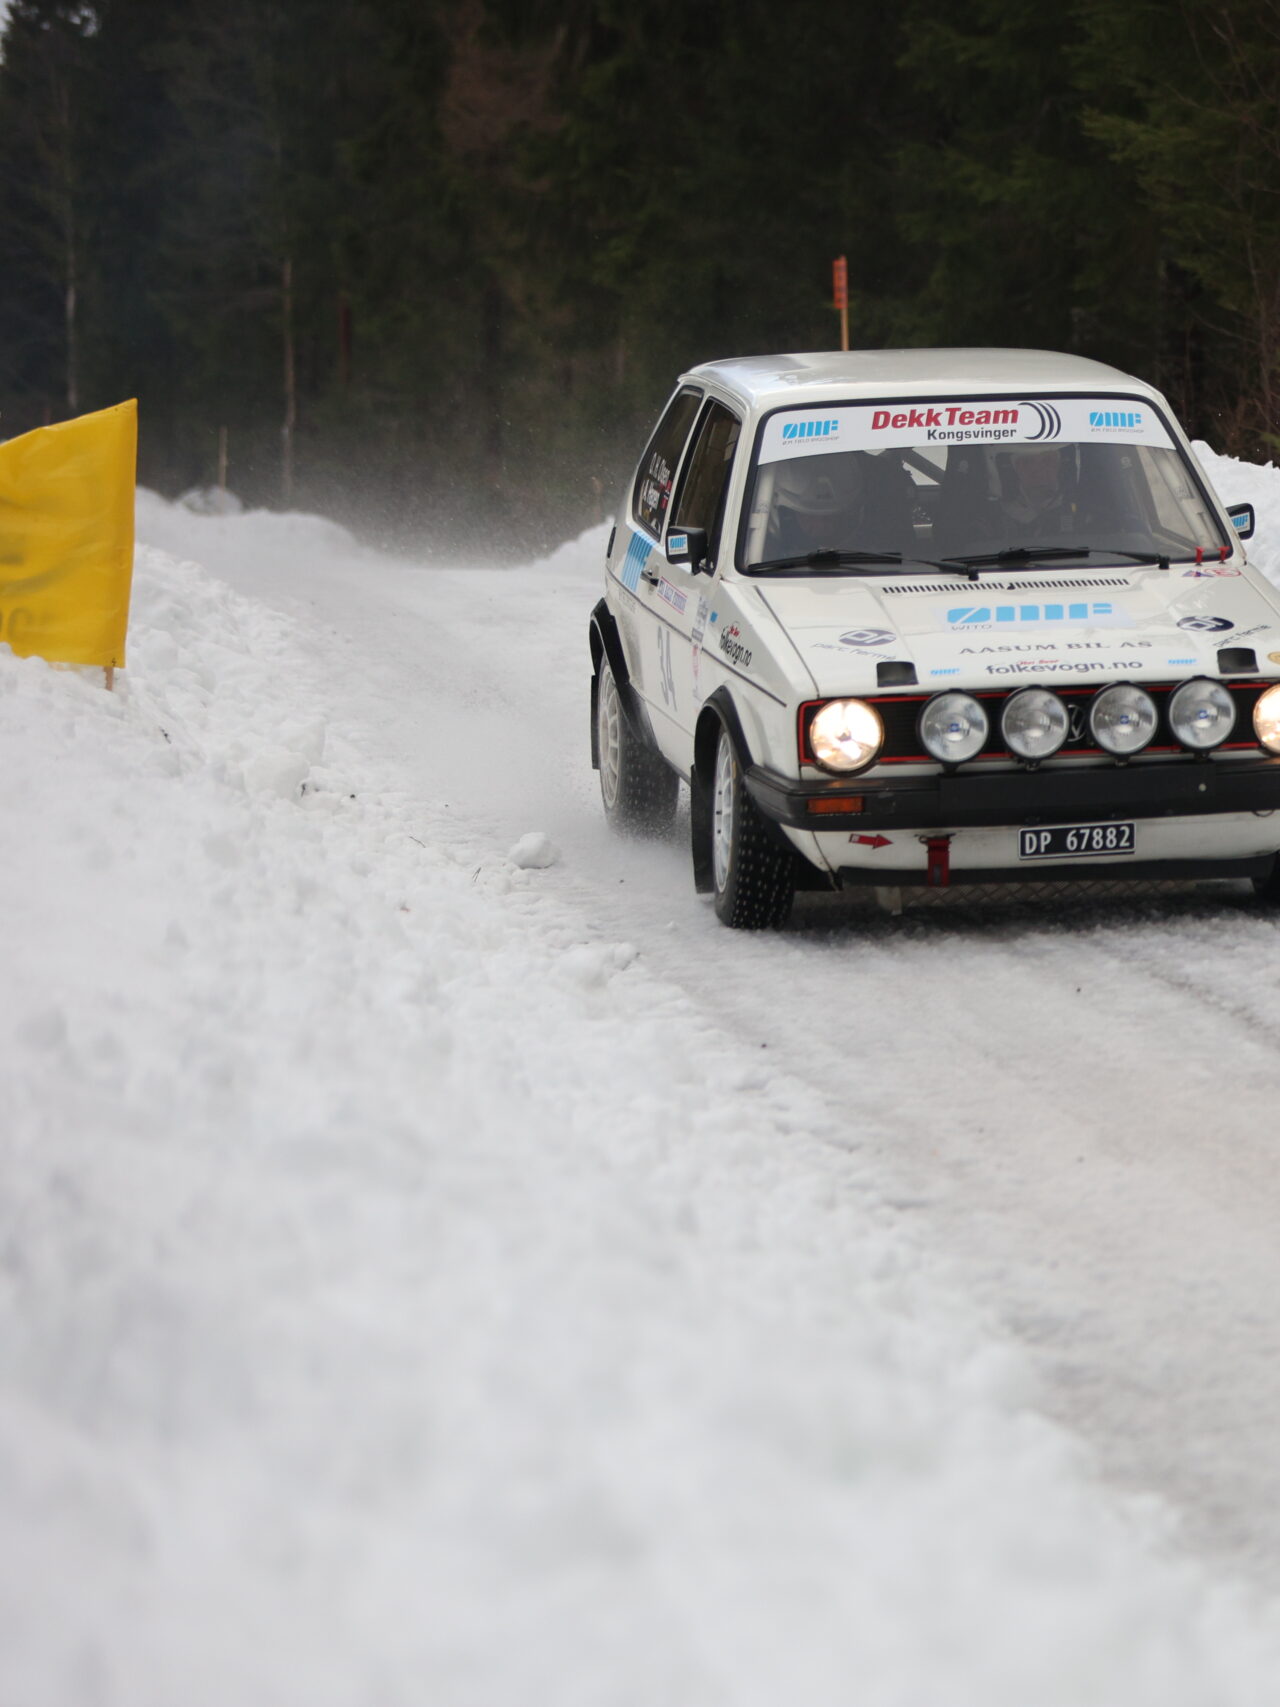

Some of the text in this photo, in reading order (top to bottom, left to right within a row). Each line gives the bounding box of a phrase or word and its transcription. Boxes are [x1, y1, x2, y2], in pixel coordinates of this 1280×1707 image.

[928, 427, 1017, 441] Kongsvinger
[959, 643, 1057, 655] AASUM
[1067, 641, 1111, 650] BIL
[986, 660, 1143, 676] folkevogn.no
[1025, 826, 1130, 854] DP 67882
